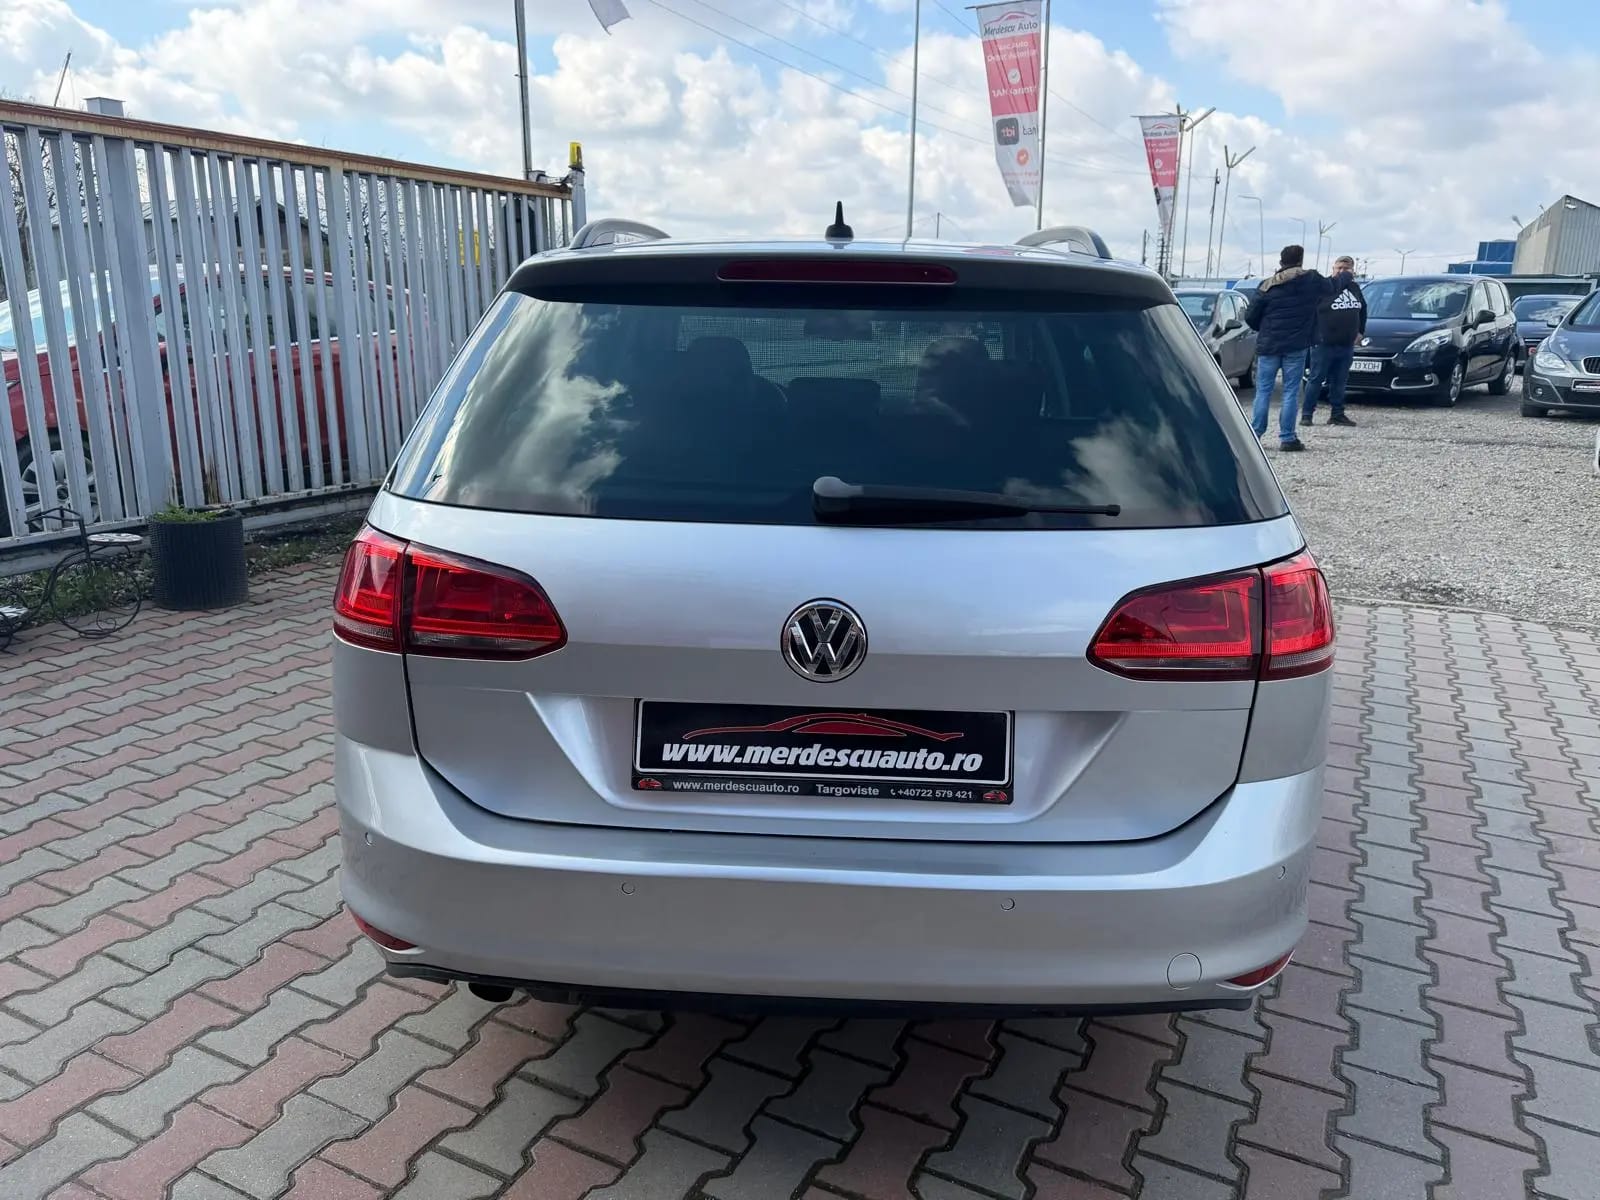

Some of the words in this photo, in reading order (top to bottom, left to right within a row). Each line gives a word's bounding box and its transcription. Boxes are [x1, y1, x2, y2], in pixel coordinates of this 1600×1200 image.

[1018, 22, 1038, 31] Auto
[662, 742, 983, 772] www.merdescuauto.ro
[673, 781, 800, 793] www.merdescuauto.ro
[816, 784, 880, 796] Targoviste
[897, 788, 933, 797] +40722
[935, 789, 953, 798] 579
[955, 790, 973, 799] 421
